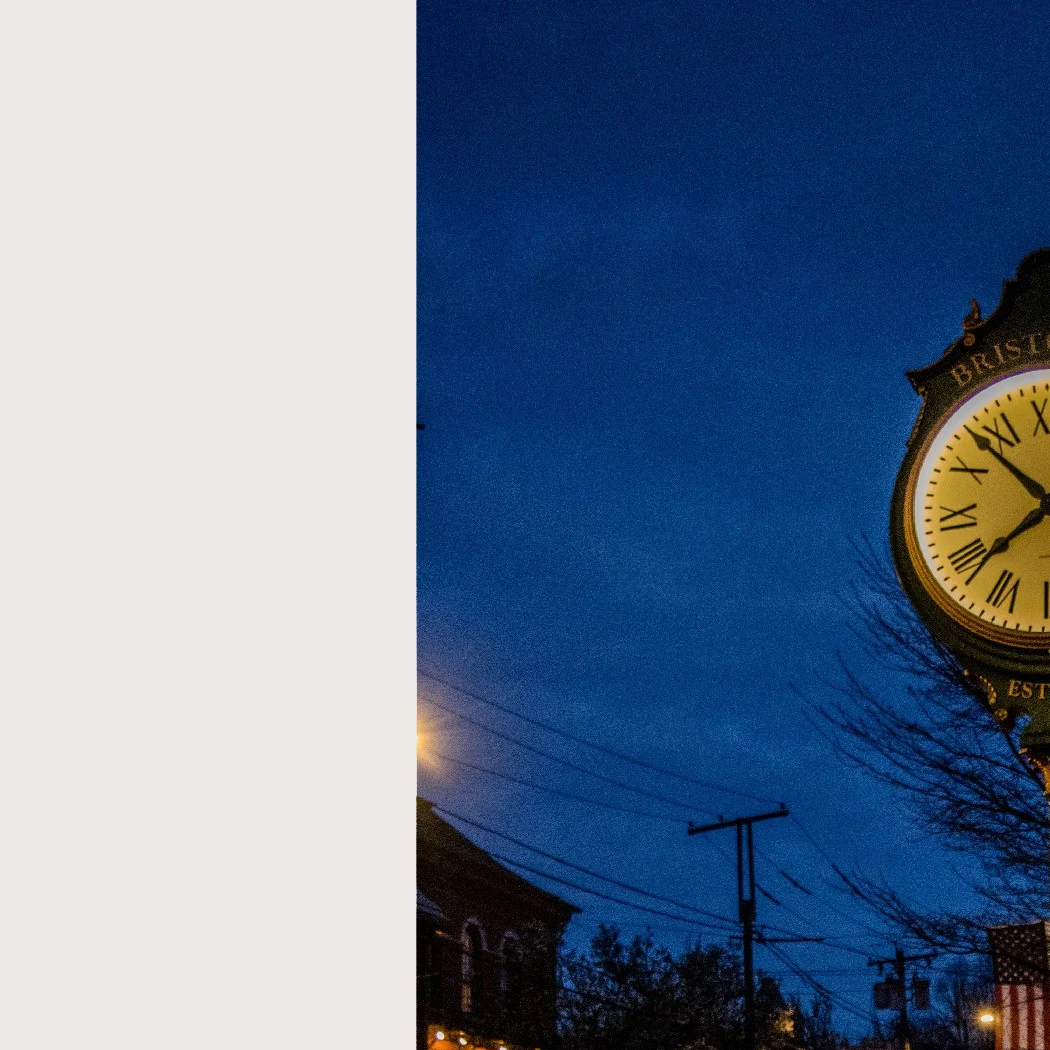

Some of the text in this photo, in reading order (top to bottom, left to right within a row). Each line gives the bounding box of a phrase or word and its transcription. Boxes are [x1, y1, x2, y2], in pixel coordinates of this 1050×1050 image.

[982, 412, 1021, 455] XI
[950, 456, 989, 485] X
[939, 503, 978, 532] IX
[986, 569, 1021, 614] VII
